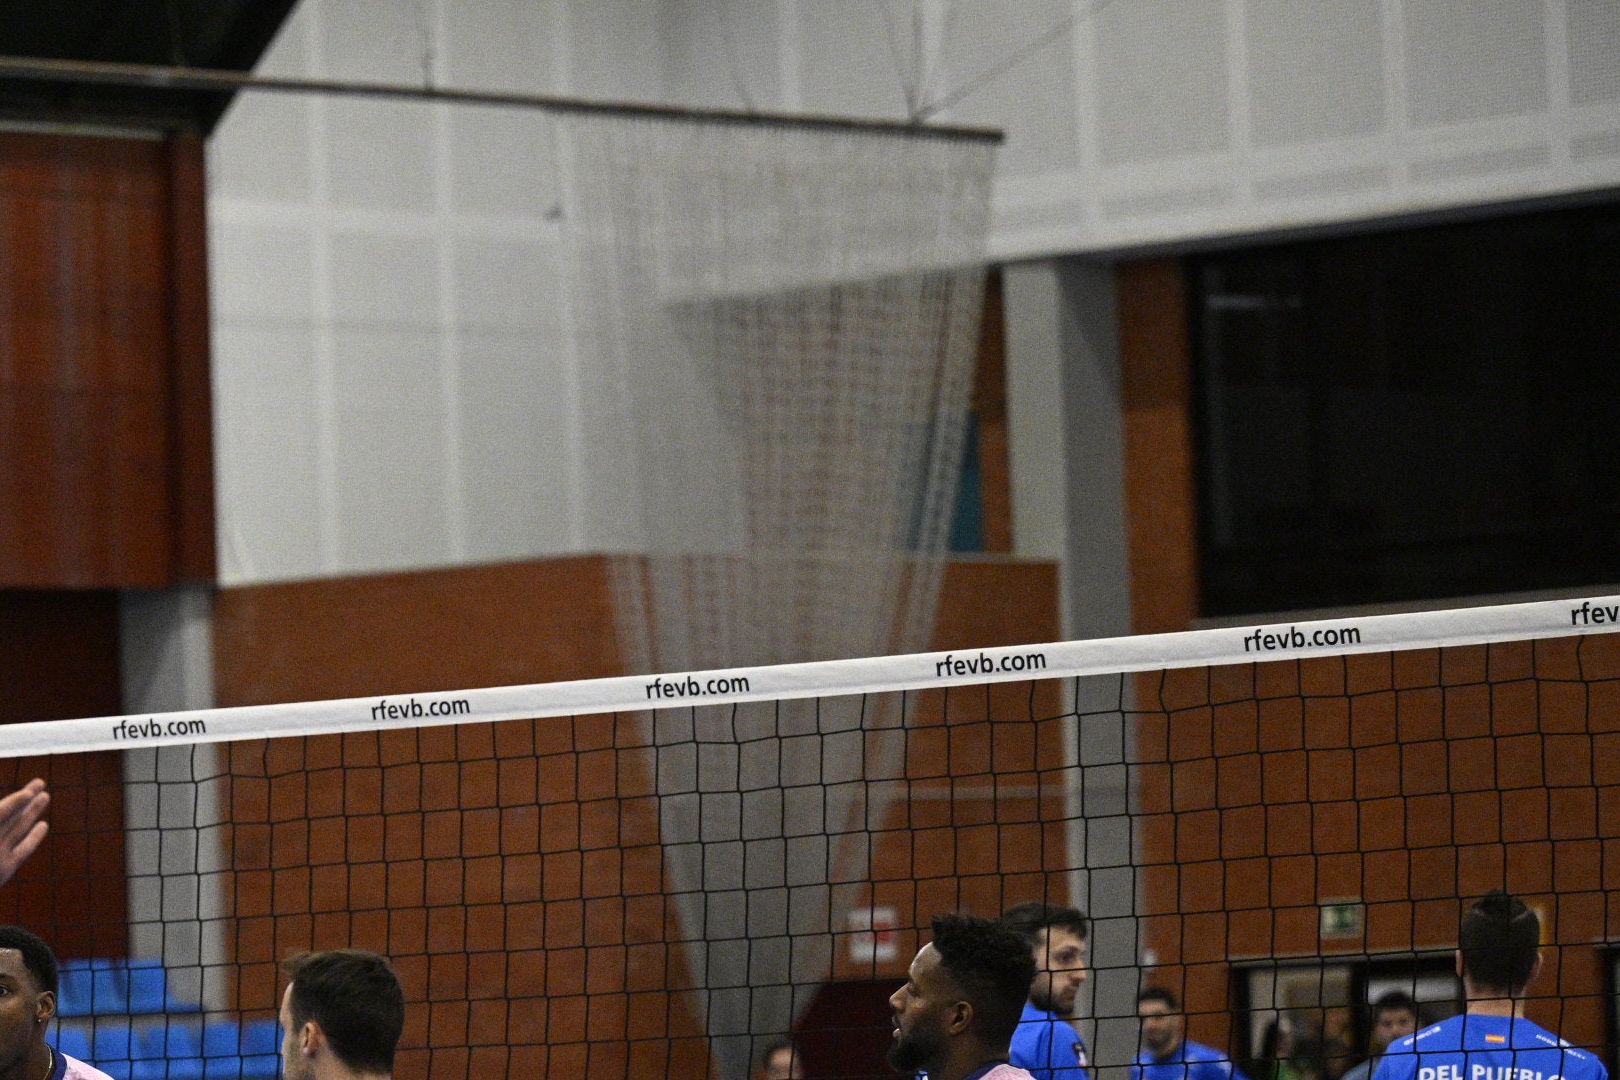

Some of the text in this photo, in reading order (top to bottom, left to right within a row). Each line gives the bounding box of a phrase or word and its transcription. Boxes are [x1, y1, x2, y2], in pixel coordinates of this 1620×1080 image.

[1571, 601, 1620, 626] rfev
[1243, 622, 1362, 653] rfevb.com
[935, 648, 1047, 678] rfevb.com
[645, 673, 751, 700] rfevb.com
[371, 696, 471, 721] rfevb.com
[112, 716, 207, 740] rfevb.com
